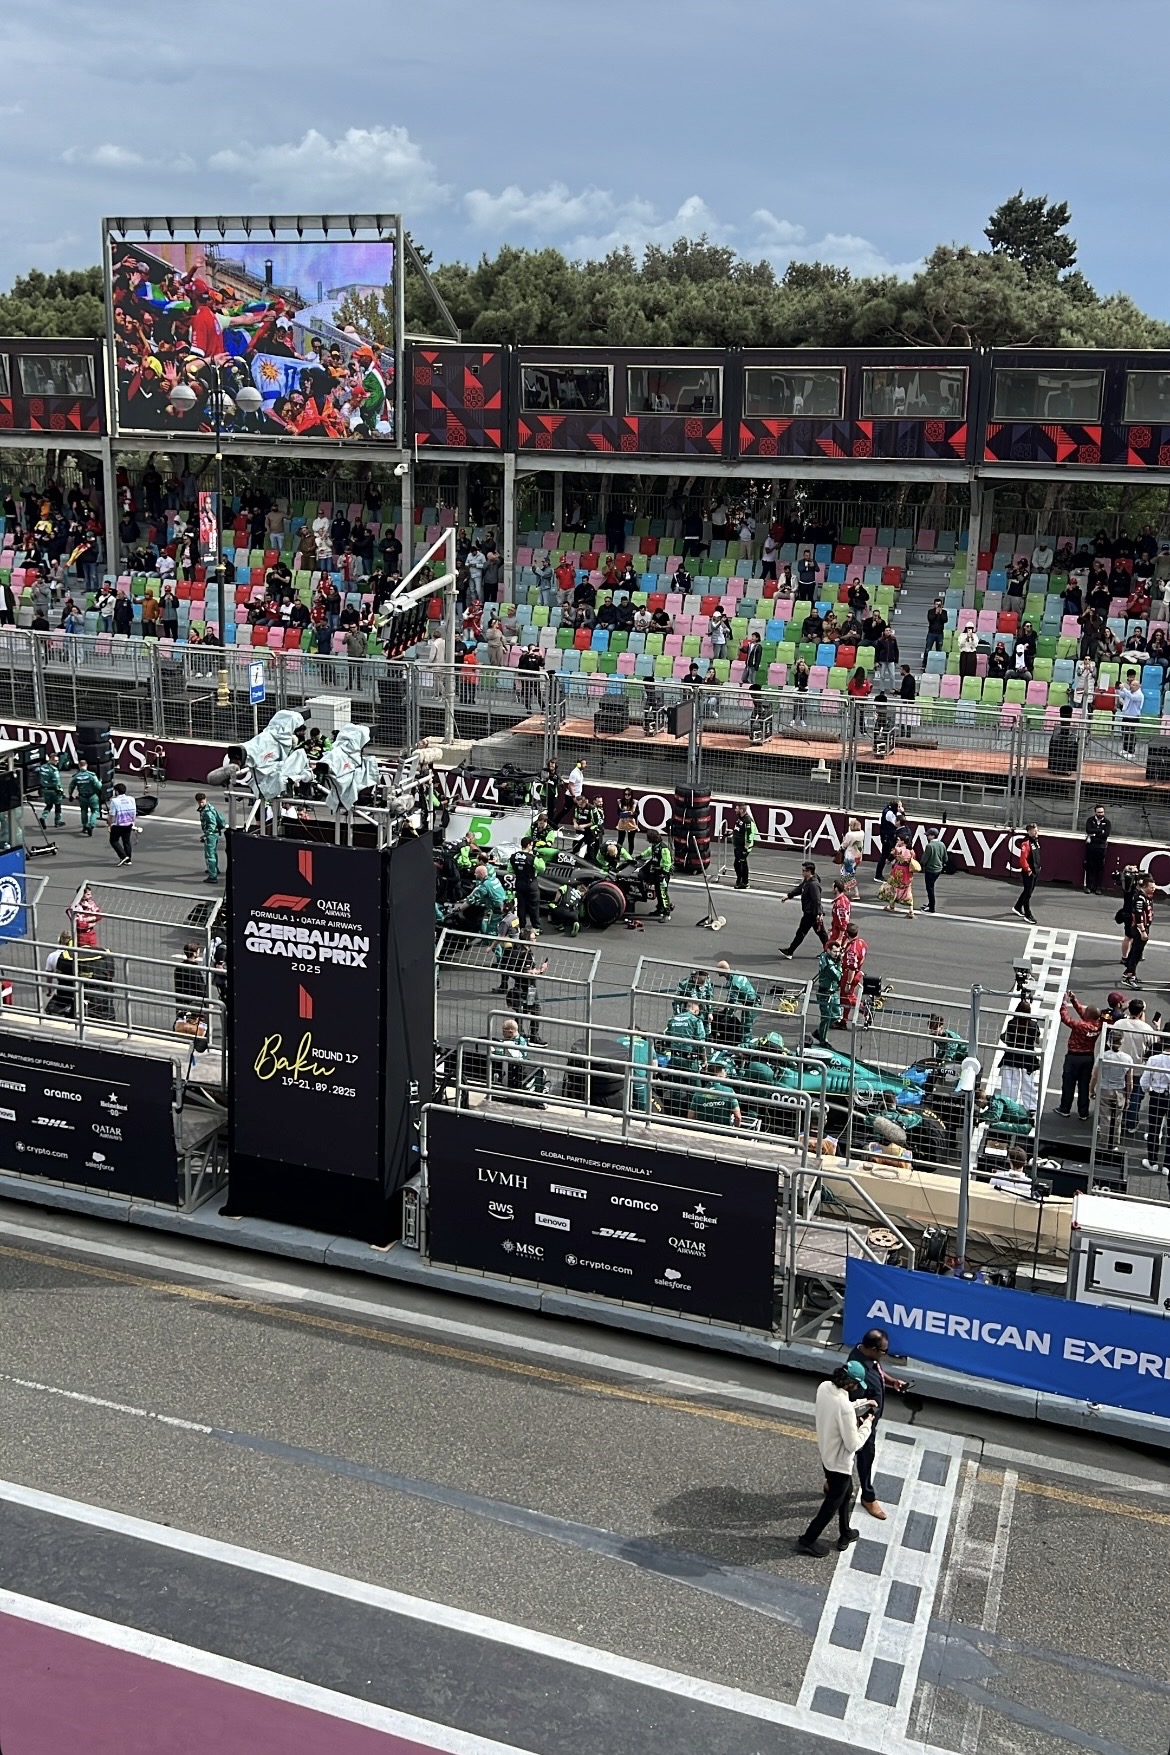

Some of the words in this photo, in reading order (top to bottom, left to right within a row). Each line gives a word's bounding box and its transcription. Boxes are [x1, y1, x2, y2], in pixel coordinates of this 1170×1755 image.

[317, 899, 351, 912] QATAR
[250, 910, 288, 921] FORMULA
[301, 916, 326, 927] QATAR
[327, 921, 363, 931] AIRWAYS
[325, 909, 351, 919] AIRWAYS
[244, 920, 370, 952] AZERBAIJAN
[245, 937, 317, 960] GRAND
[319, 946, 368, 969] PRIX
[291, 962, 321, 974] 2025
[7, 1053, 35, 1063] PARTNERS
[43, 1059, 70, 1069] FORMULA
[254, 1032, 335, 1080] Baku
[312, 1048, 343, 1062] ROUND
[345, 1053, 359, 1064] 17
[282, 1076, 356, 1097] 19-21.09.2025
[902, 1078, 911, 1086] 18
[44, 1088, 82, 1102] aramco
[100, 1100, 128, 1111] Heineken
[37, 1117, 69, 1129] DHL
[92, 1124, 122, 1136] QATAR
[26, 1145, 69, 1159] crypto.com
[85, 1160, 115, 1172] salesforce
[540, 1150, 565, 1161] GLOBAL
[566, 1155, 601, 1167] PARTNERS
[612, 1164, 645, 1176] FORMULA
[477, 1168, 528, 1190] LVMH
[550, 1183, 588, 1199] PIRELLI
[610, 1196, 659, 1212] aramco
[489, 1200, 514, 1214] aws
[682, 1211, 718, 1225] Heineken
[538, 1216, 567, 1228] Lenovo
[599, 1227, 639, 1242] DHL
[516, 1242, 544, 1256] MSC
[668, 1236, 706, 1252] QATAR
[677, 1247, 707, 1257] AIRWAYS
[579, 1259, 633, 1275] crypto.com
[654, 1278, 692, 1291] salesforce
[866, 1299, 1051, 1355] AMERICAN
